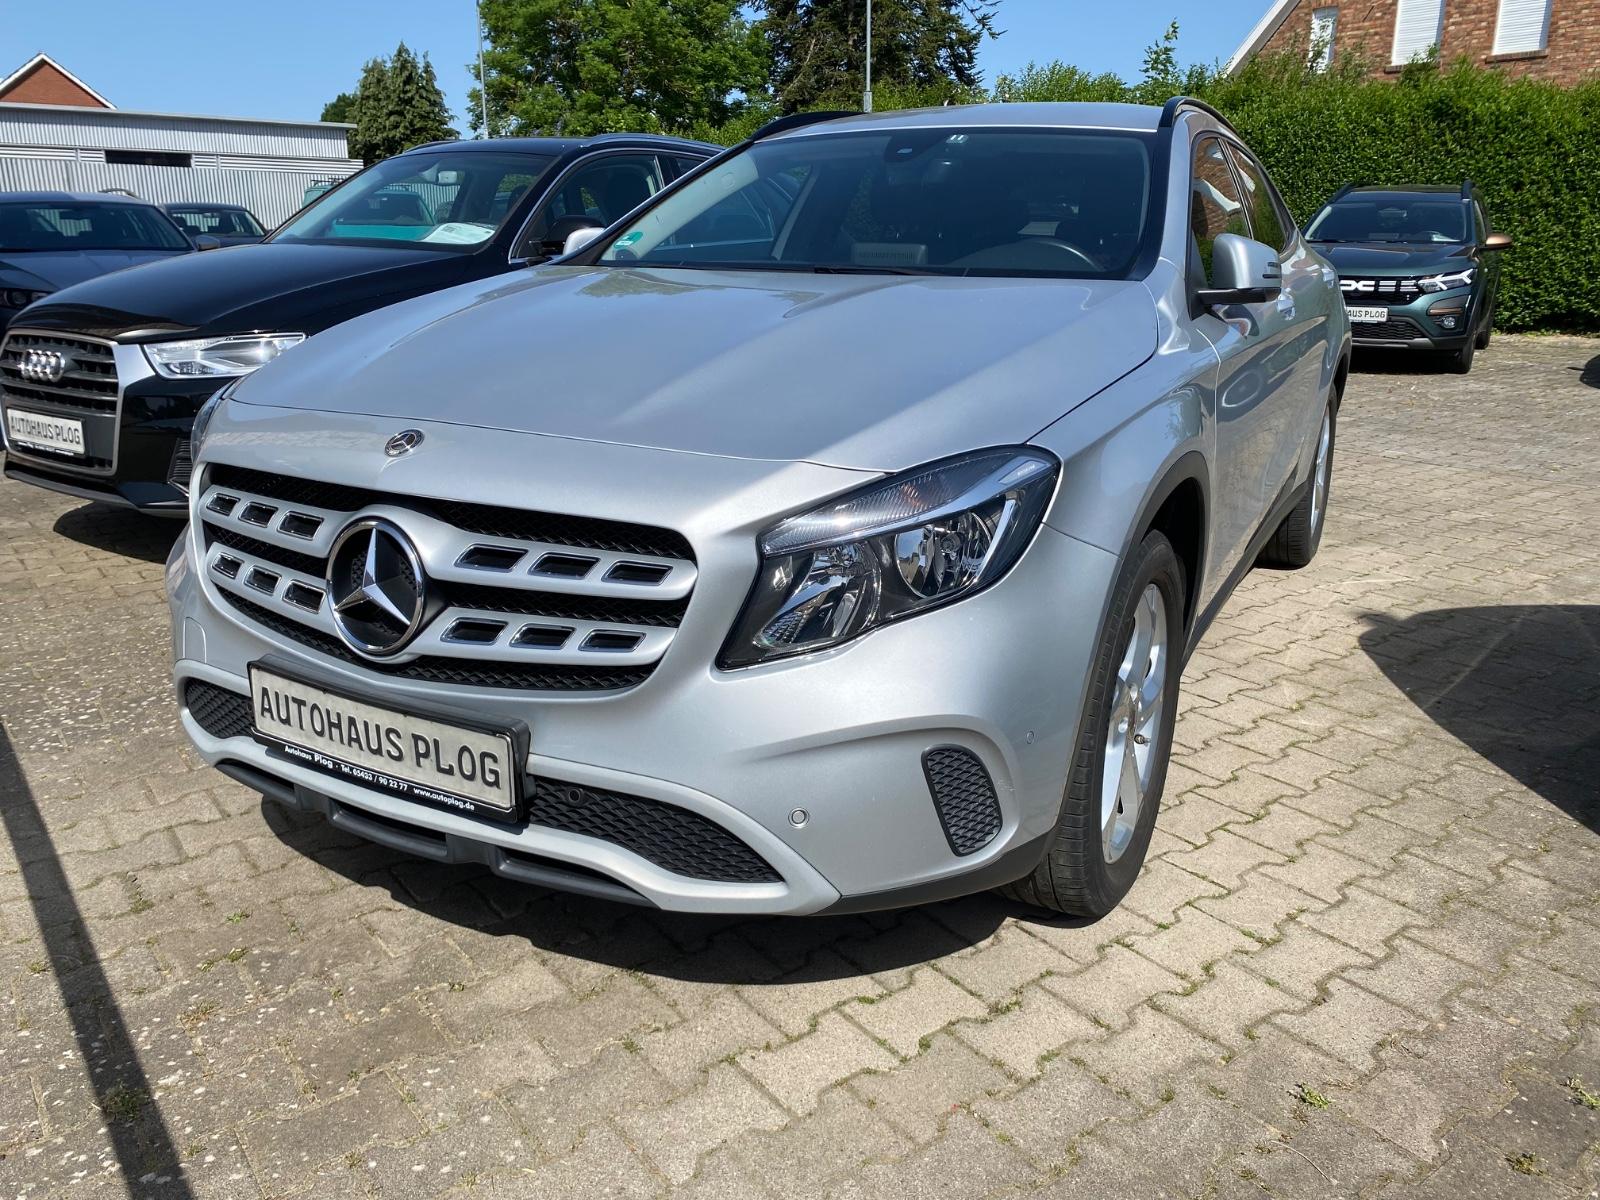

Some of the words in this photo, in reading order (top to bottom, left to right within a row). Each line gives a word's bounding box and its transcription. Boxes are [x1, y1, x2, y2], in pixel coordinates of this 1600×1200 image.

[1364, 310, 1386, 318] PLOG
[11, 416, 53, 440] AUTOHAUS
[54, 424, 81, 445] PLOG
[260, 686, 404, 762] AUTOHAUS
[411, 732, 502, 790] PLOG
[284, 745, 313, 761] Autohaus
[314, 753, 334, 769] Plog
[340, 764, 352, 775] Tel.
[378, 776, 388, 785] 90
[388, 780, 398, 789] 22
[399, 783, 408, 792] 77
[413, 787, 475, 811] www.autoplog.de
